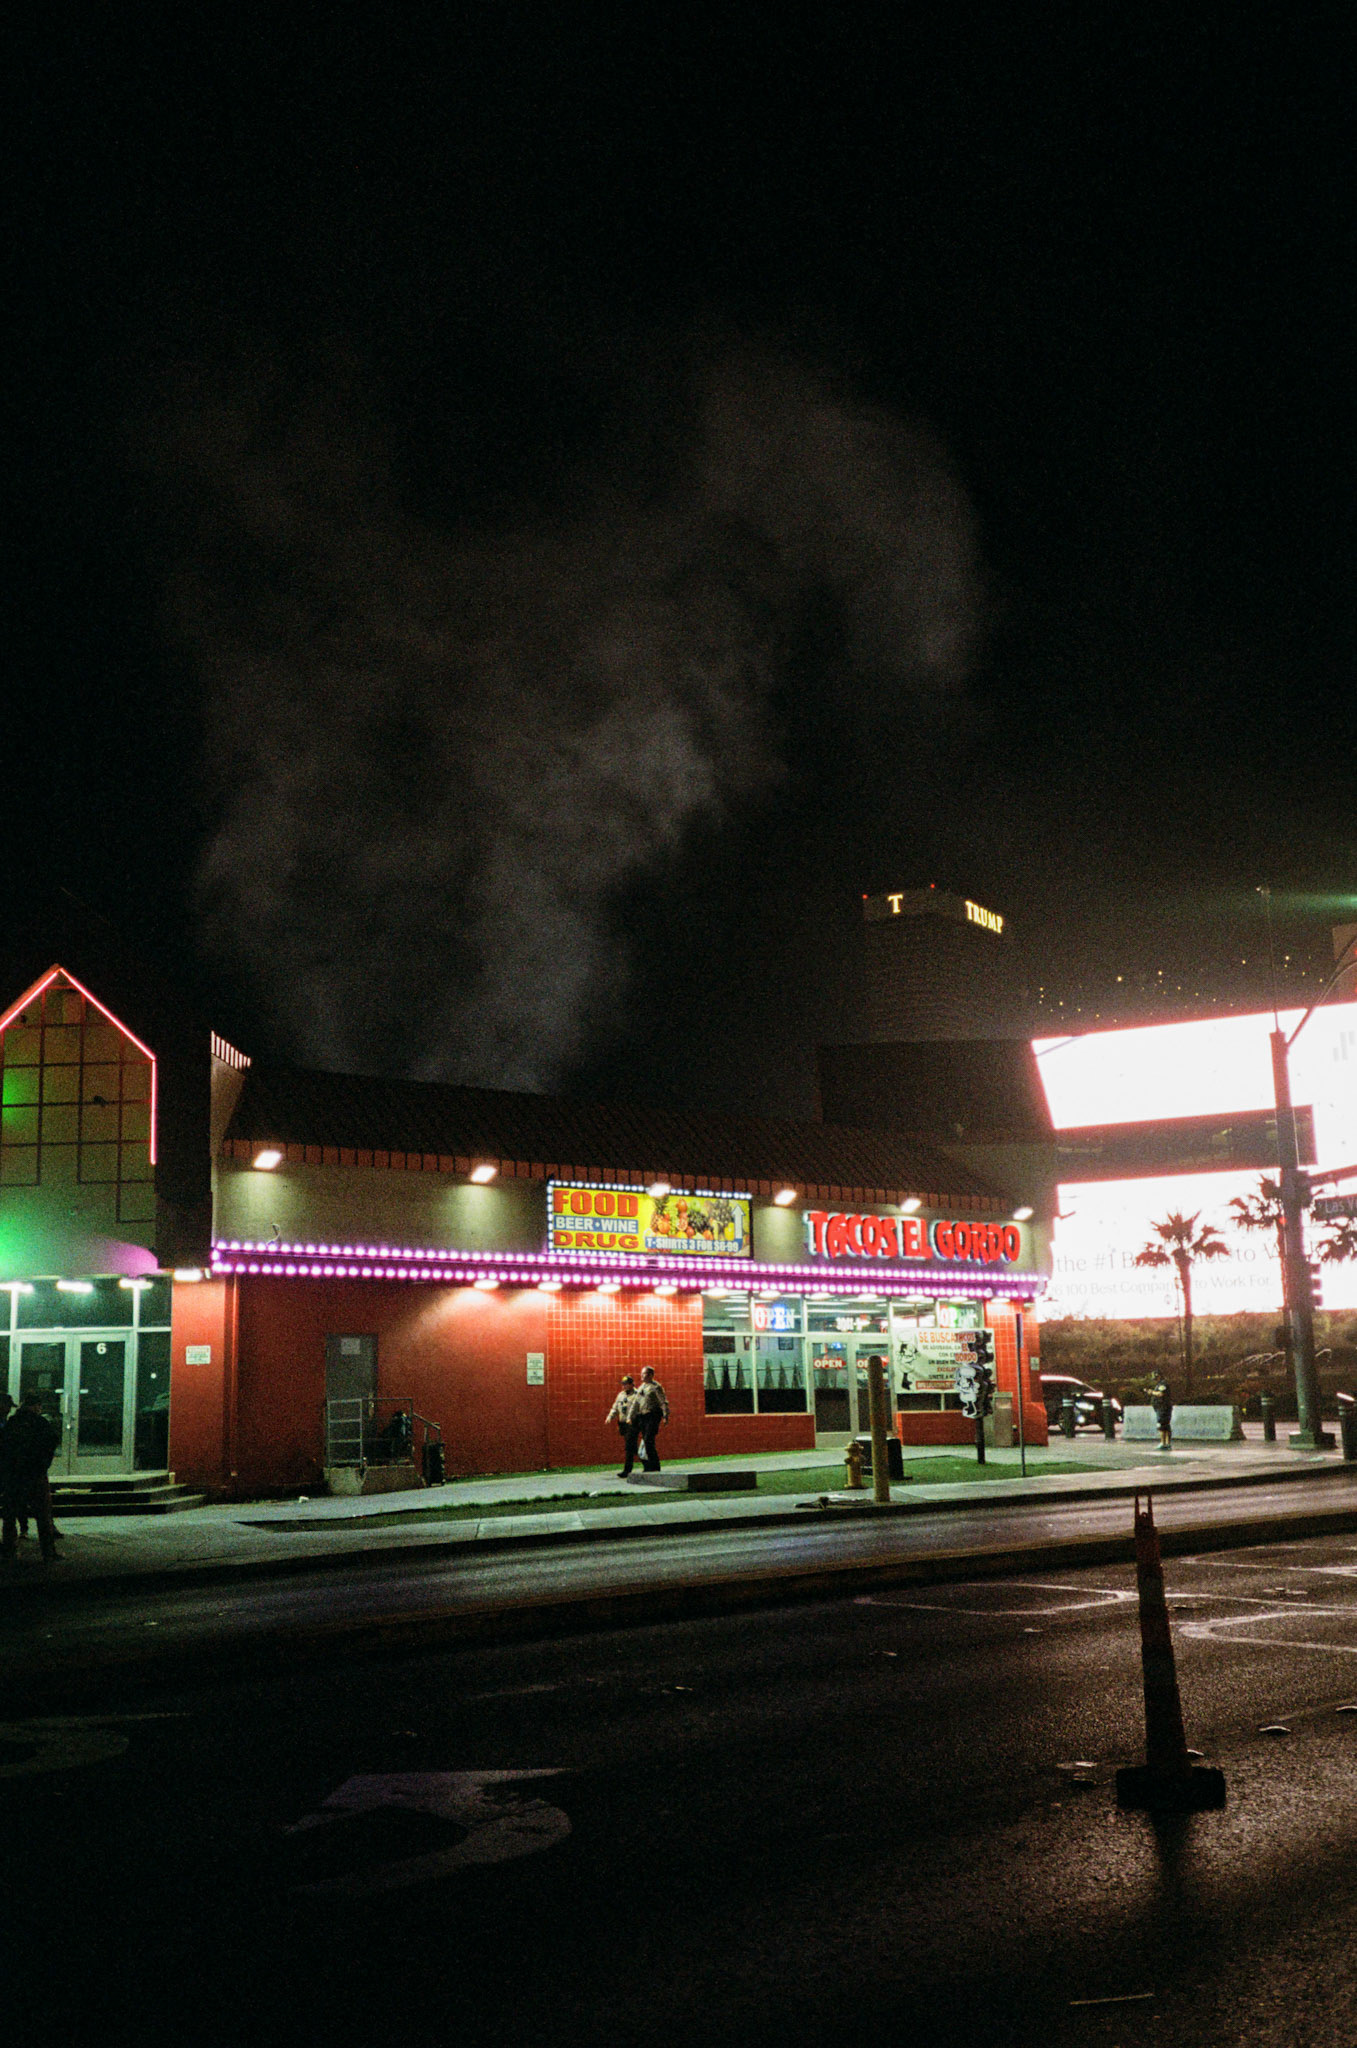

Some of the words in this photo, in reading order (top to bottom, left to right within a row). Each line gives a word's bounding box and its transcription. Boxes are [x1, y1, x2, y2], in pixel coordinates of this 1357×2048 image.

[887, 893, 904, 914] T
[964, 900, 1004, 934] TRUMP
[553, 1189, 638, 1217] FOOD
[555, 1216, 594, 1231] BEER
[600, 1218, 637, 1233] WINE
[553, 1231, 639, 1249] DRUG
[647, 1237, 688, 1250] T-SHIRTS
[689, 1239, 695, 1250] 3
[696, 1240, 713, 1251] FOR
[804, 1210, 898, 1259] TACOS
[901, 1217, 932, 1259] EL
[932, 1220, 1021, 1265] GORDO
[1056, 1254, 1087, 1272] the
[1095, 1252, 1115, 1270] #1
[1236, 1248, 1256, 1262] to
[1066, 1283, 1087, 1296] 100
[1090, 1282, 1117, 1295] Best
[1194, 1278, 1207, 1289] to
[1210, 1275, 1245, 1288] Work
[754, 1303, 796, 1330] OPEN
[96, 1343, 107, 1354] 6
[814, 1359, 843, 1368] OPEN
